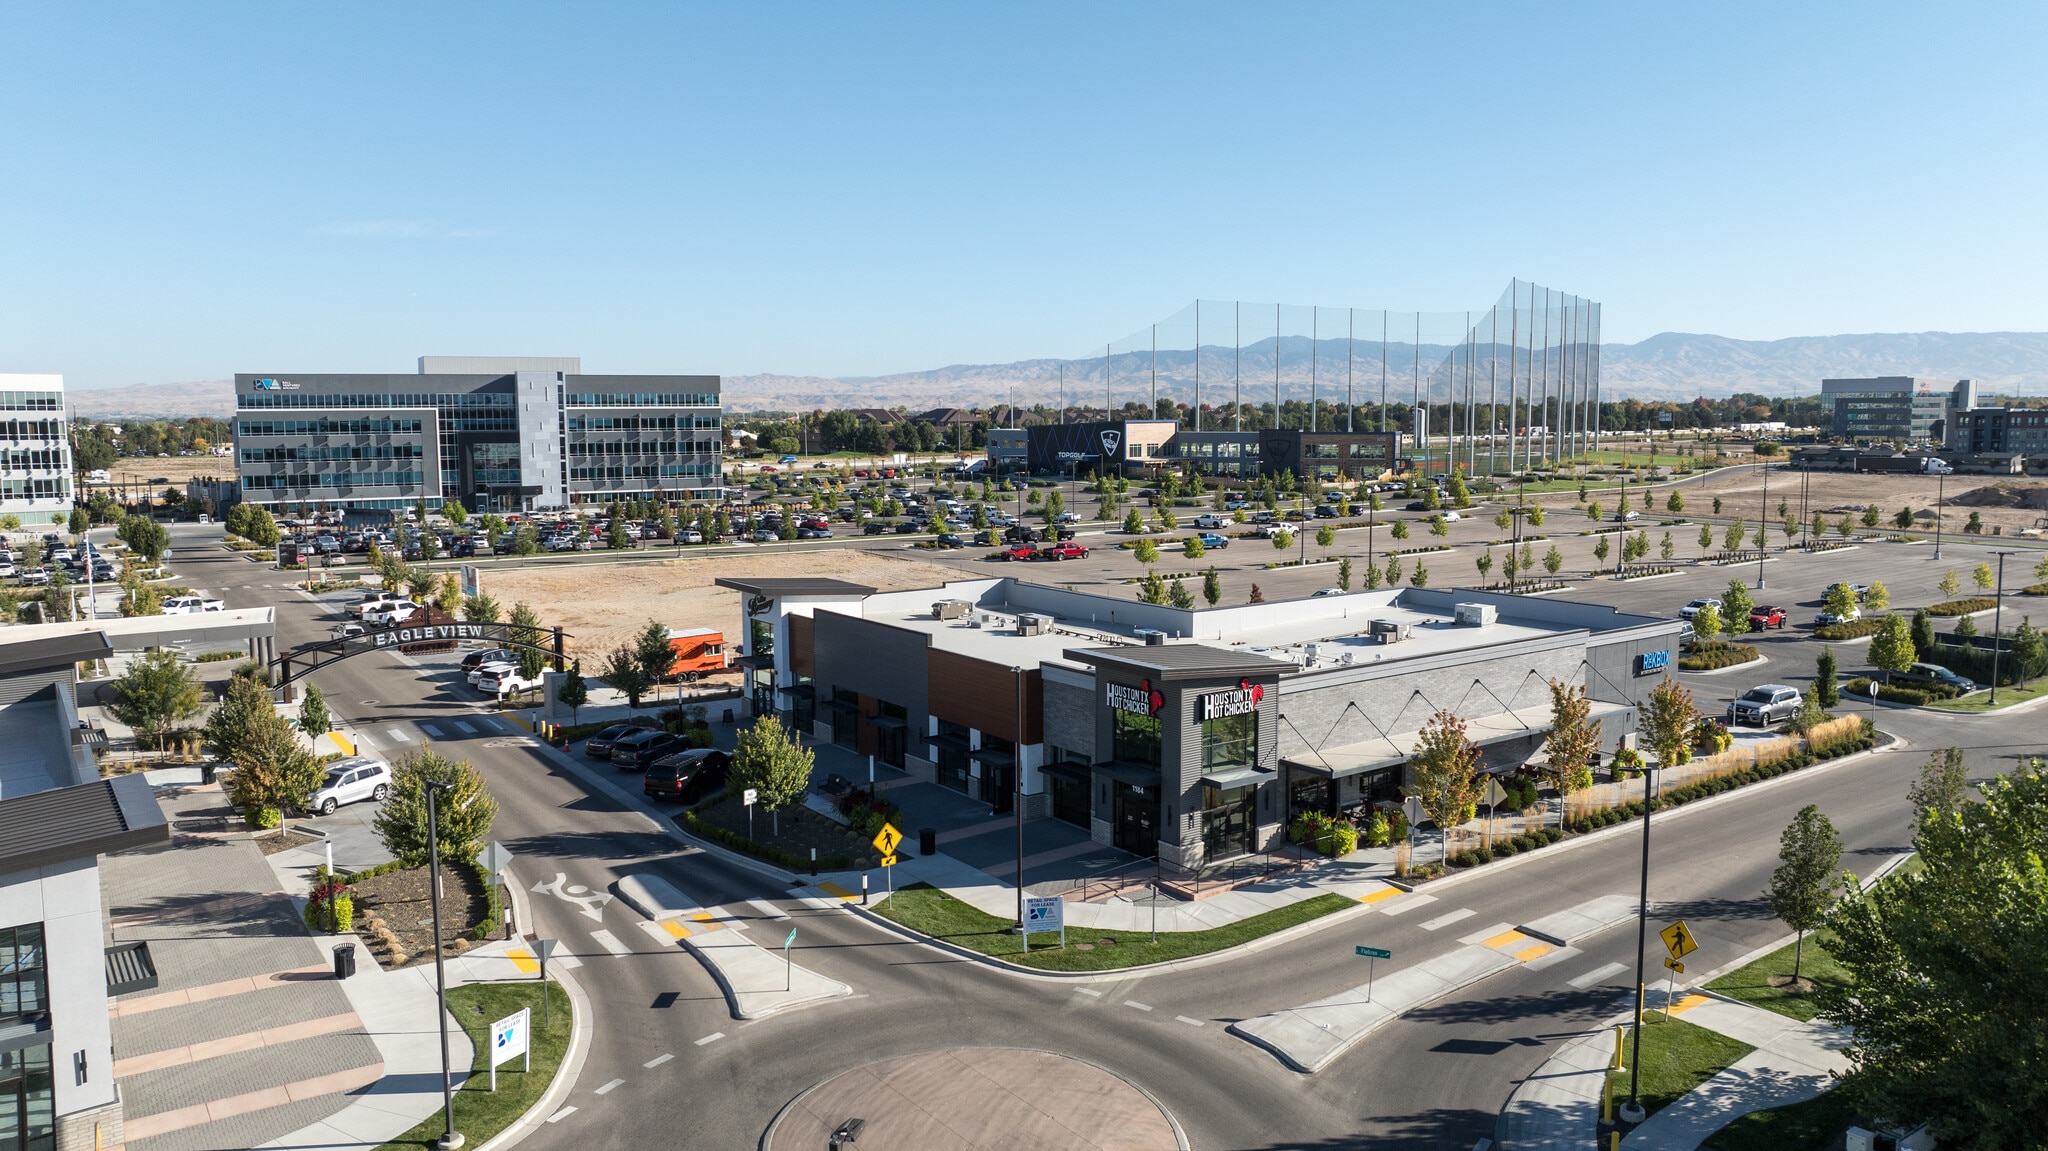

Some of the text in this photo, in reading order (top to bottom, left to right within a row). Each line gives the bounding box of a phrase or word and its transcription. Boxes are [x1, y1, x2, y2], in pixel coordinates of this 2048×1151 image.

[375, 625, 482, 646] EAGLE VIEW
[1106, 683, 1149, 705] HOUSTON TX
[1204, 688, 1253, 714] HOUSTON TX
[1122, 700, 1150, 716] CHICKEN
[1224, 702, 1254, 718] CHICKEN
